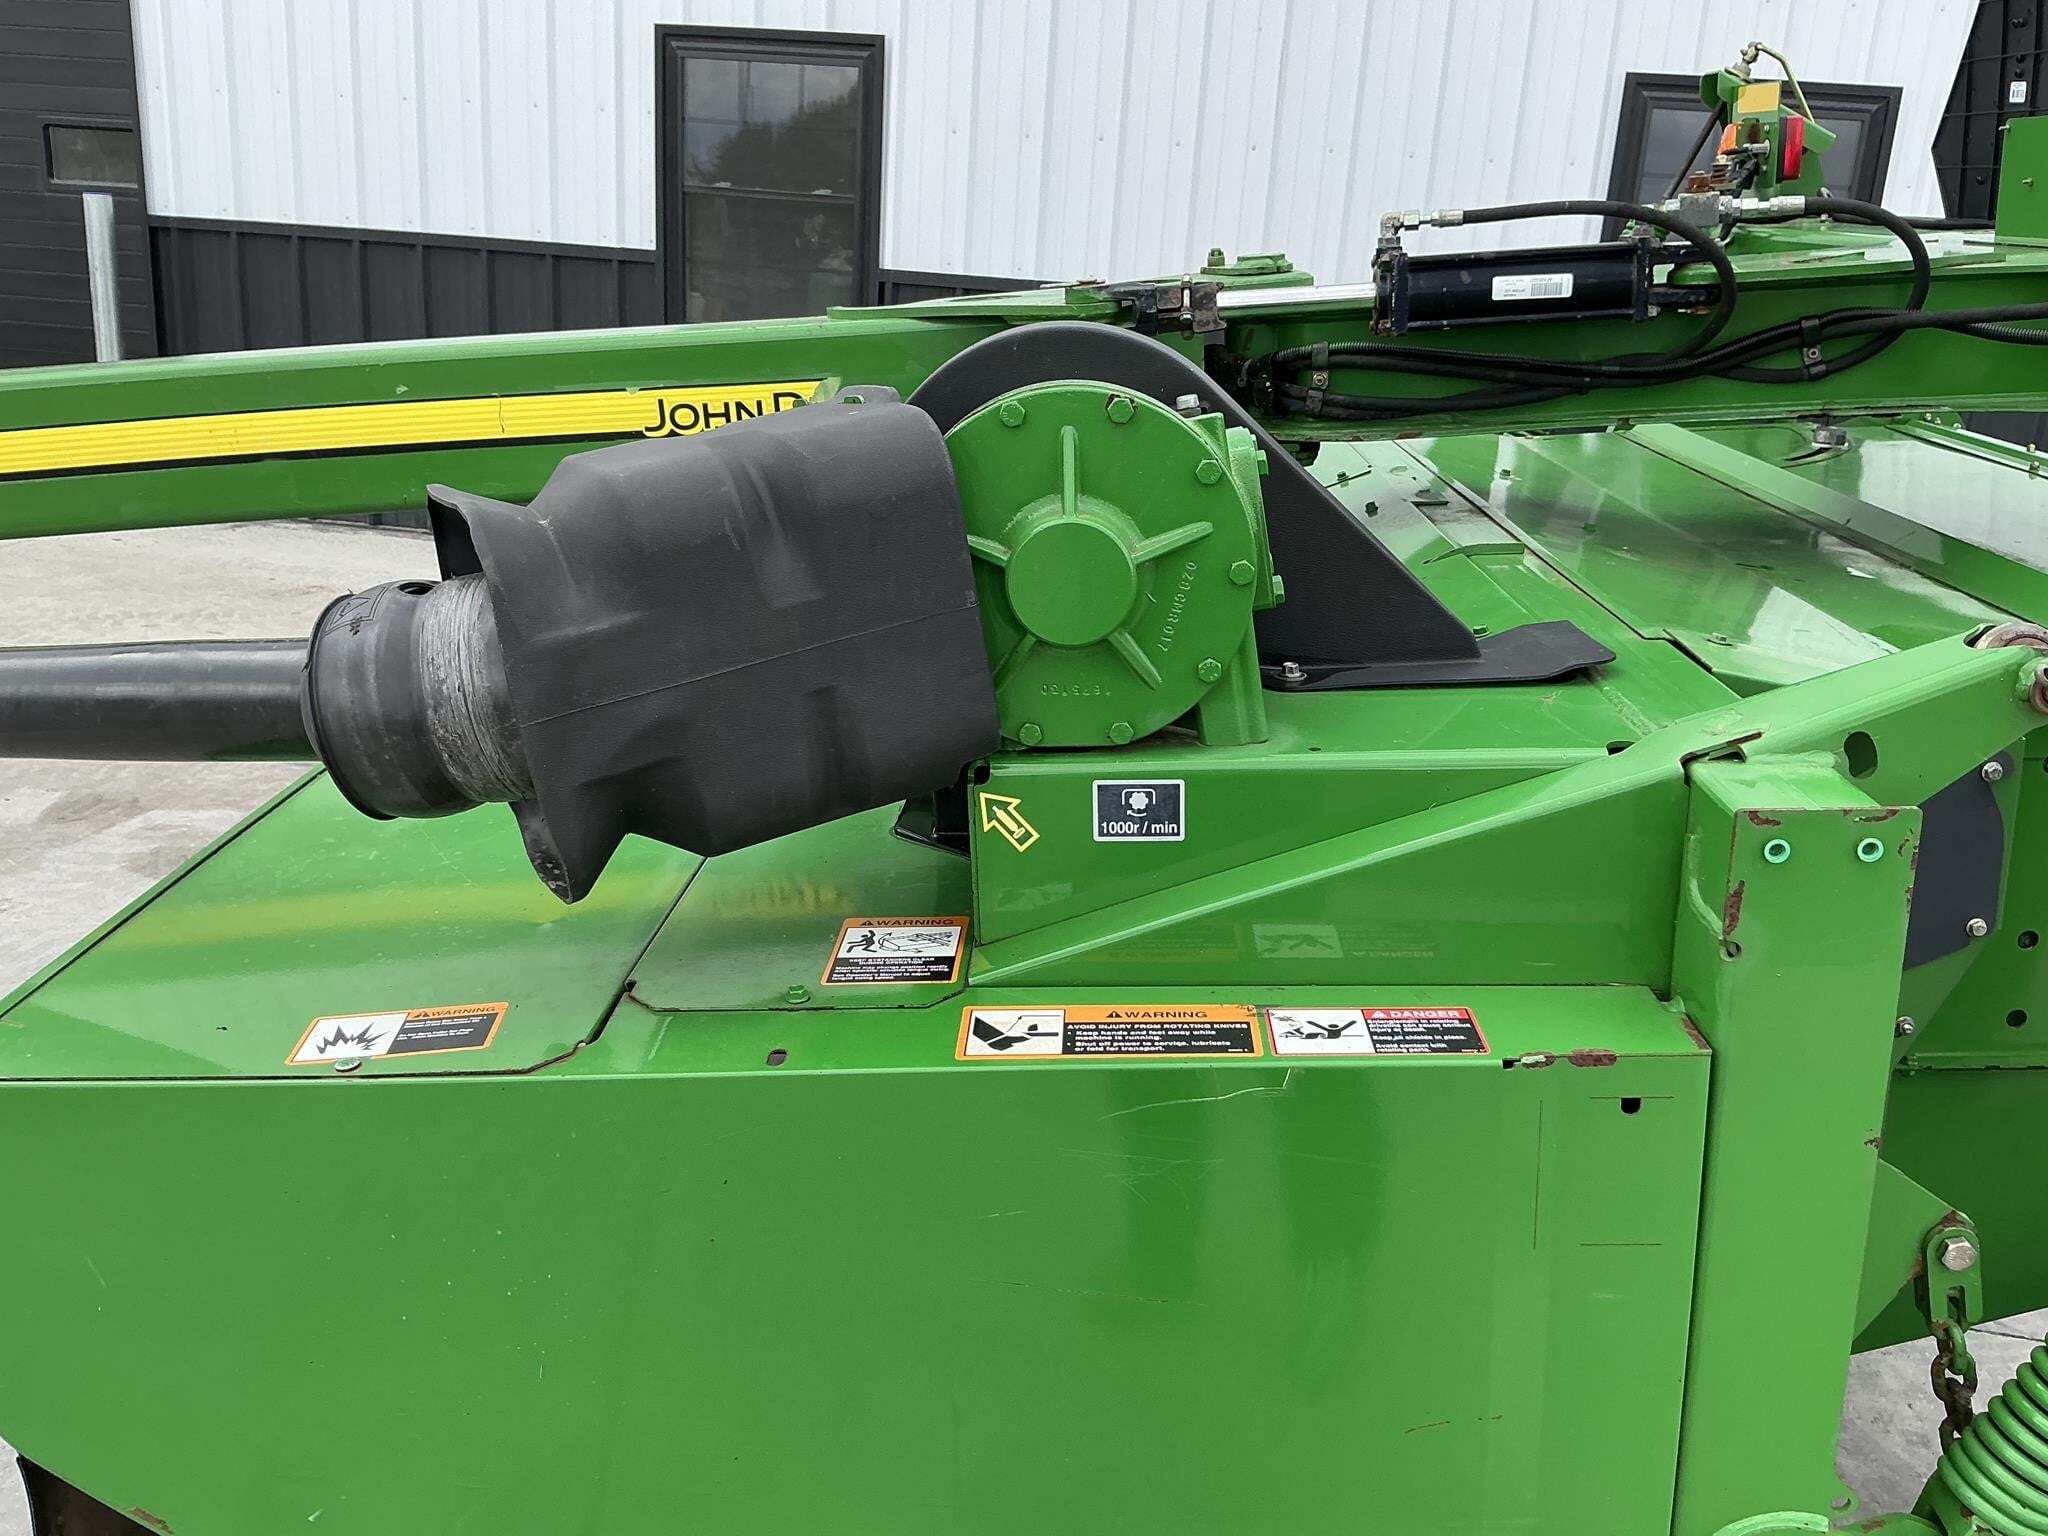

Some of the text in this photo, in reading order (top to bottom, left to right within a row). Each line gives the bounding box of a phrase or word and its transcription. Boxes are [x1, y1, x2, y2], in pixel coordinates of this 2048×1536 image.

[645, 398, 763, 432] JOHN
[1101, 821, 1140, 834] 1000r
[1151, 821, 1178, 834] min
[431, 1006, 496, 1017] WARNING
[1389, 1010, 1460, 1019] DANGER
